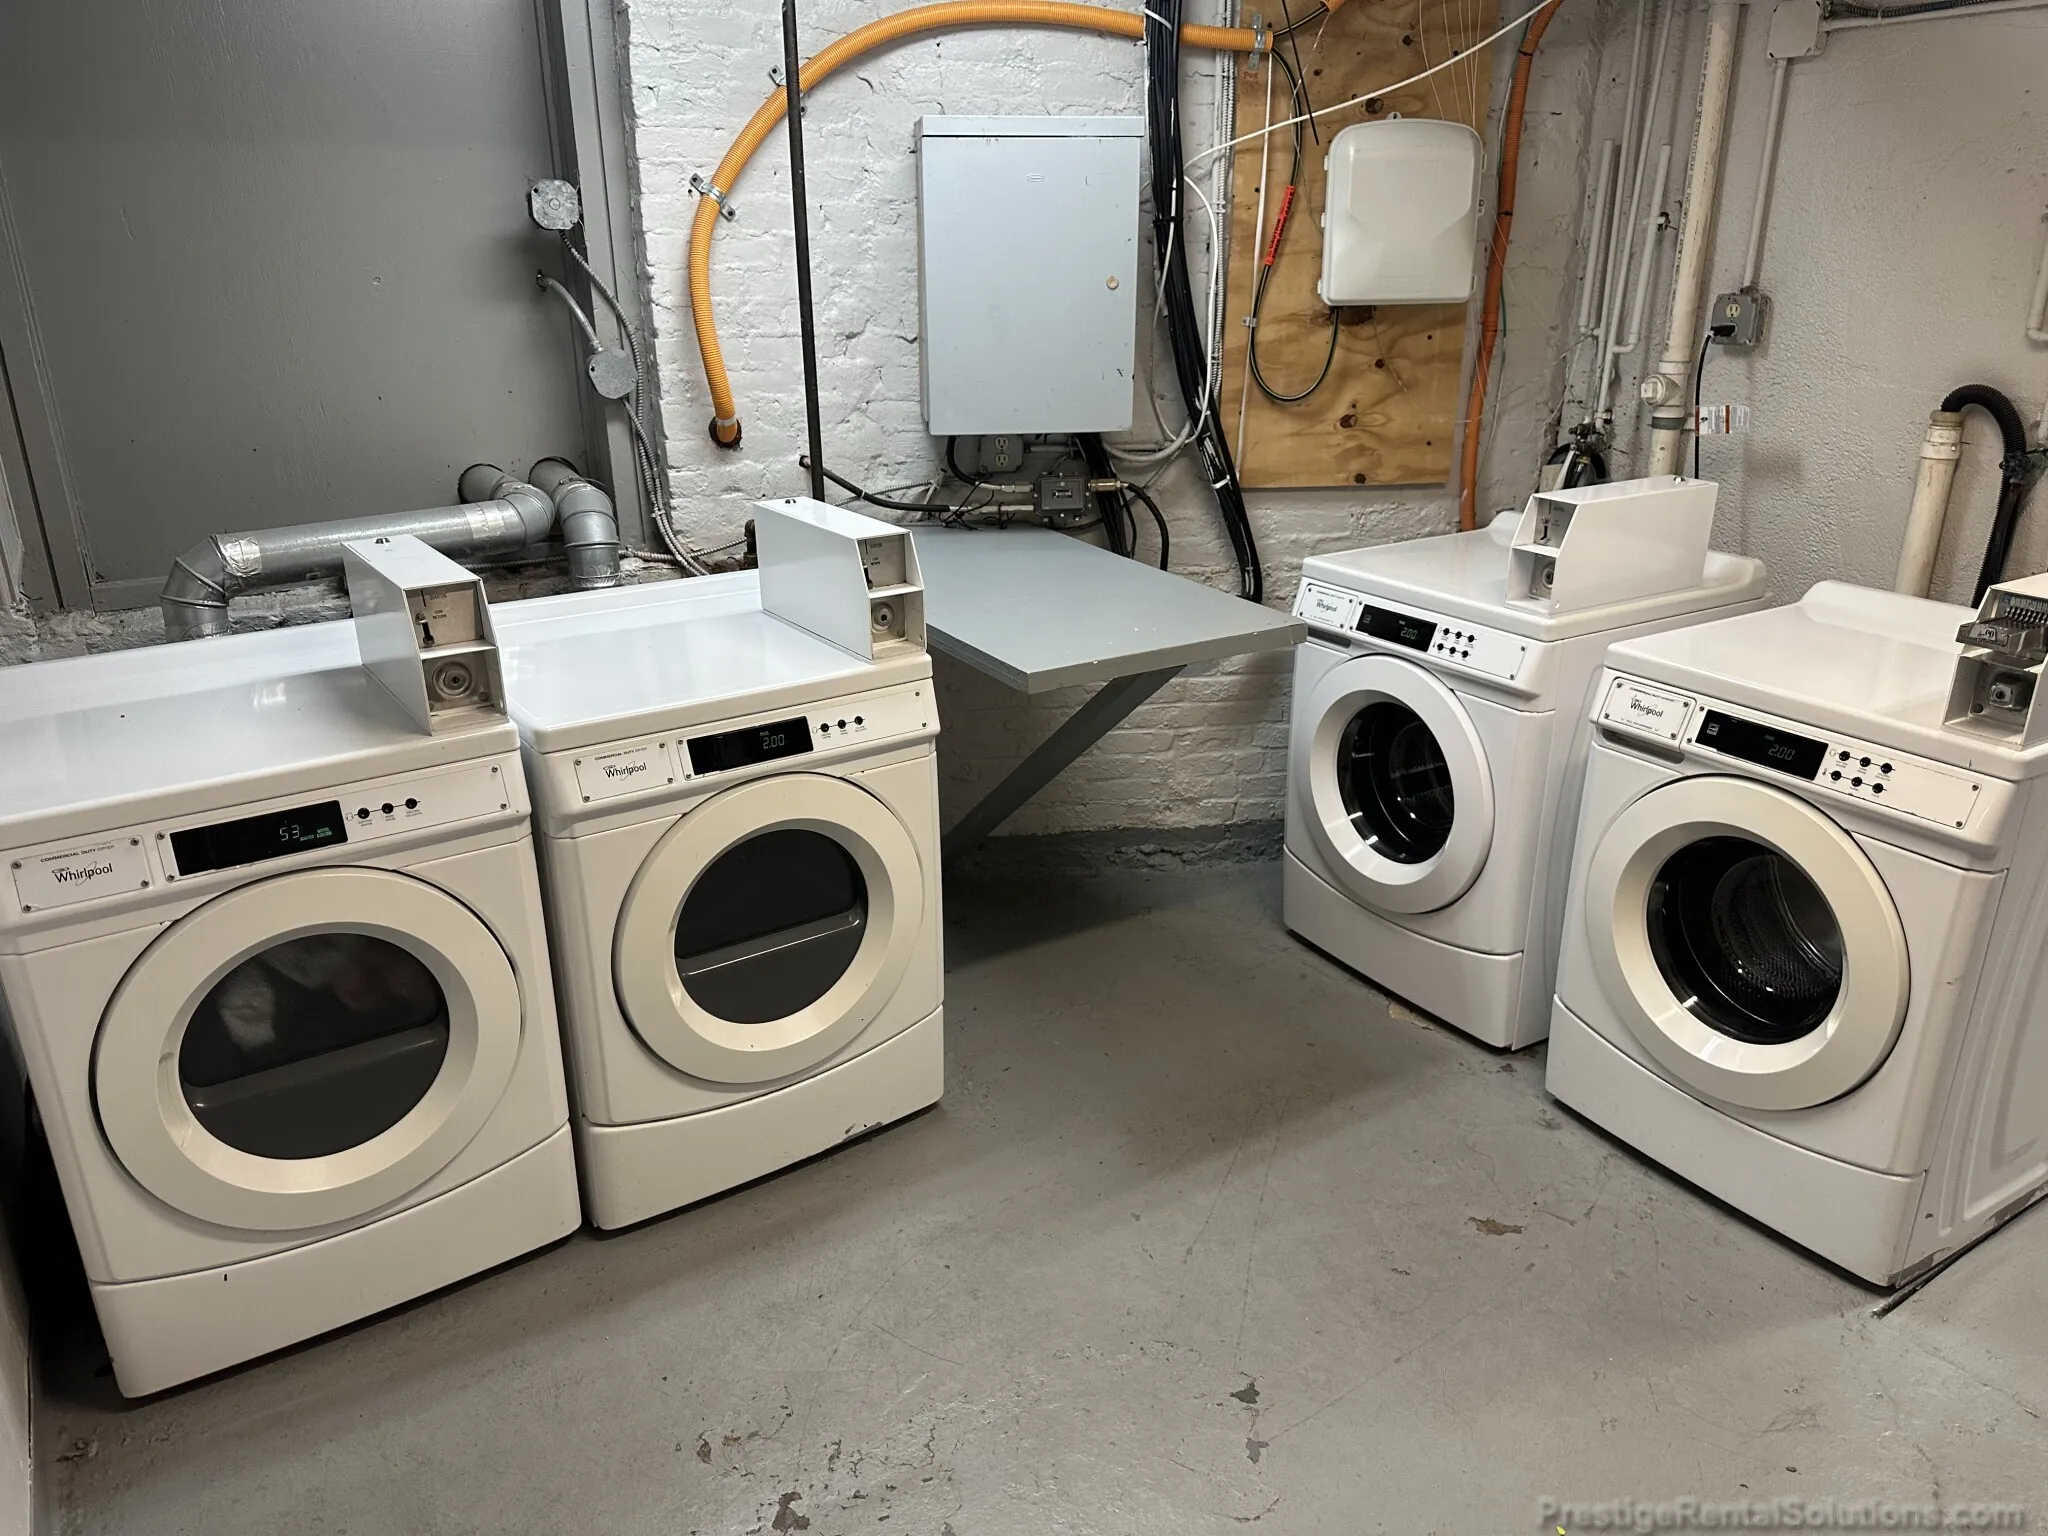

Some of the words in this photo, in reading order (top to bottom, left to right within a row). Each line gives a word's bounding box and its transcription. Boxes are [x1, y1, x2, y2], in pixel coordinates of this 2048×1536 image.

[1269, 218, 1281, 249] CAUTION
[1630, 700, 1664, 718] Whirlpool
[762, 734, 785, 749] 2.00
[1768, 744, 1796, 761] 2.00
[604, 762, 647, 778] Whirlpool
[279, 825, 300, 841] 53
[40, 852, 80, 863] COMMERCIAL
[97, 844, 115, 852] DRYER
[54, 863, 113, 883] Whirlpool
